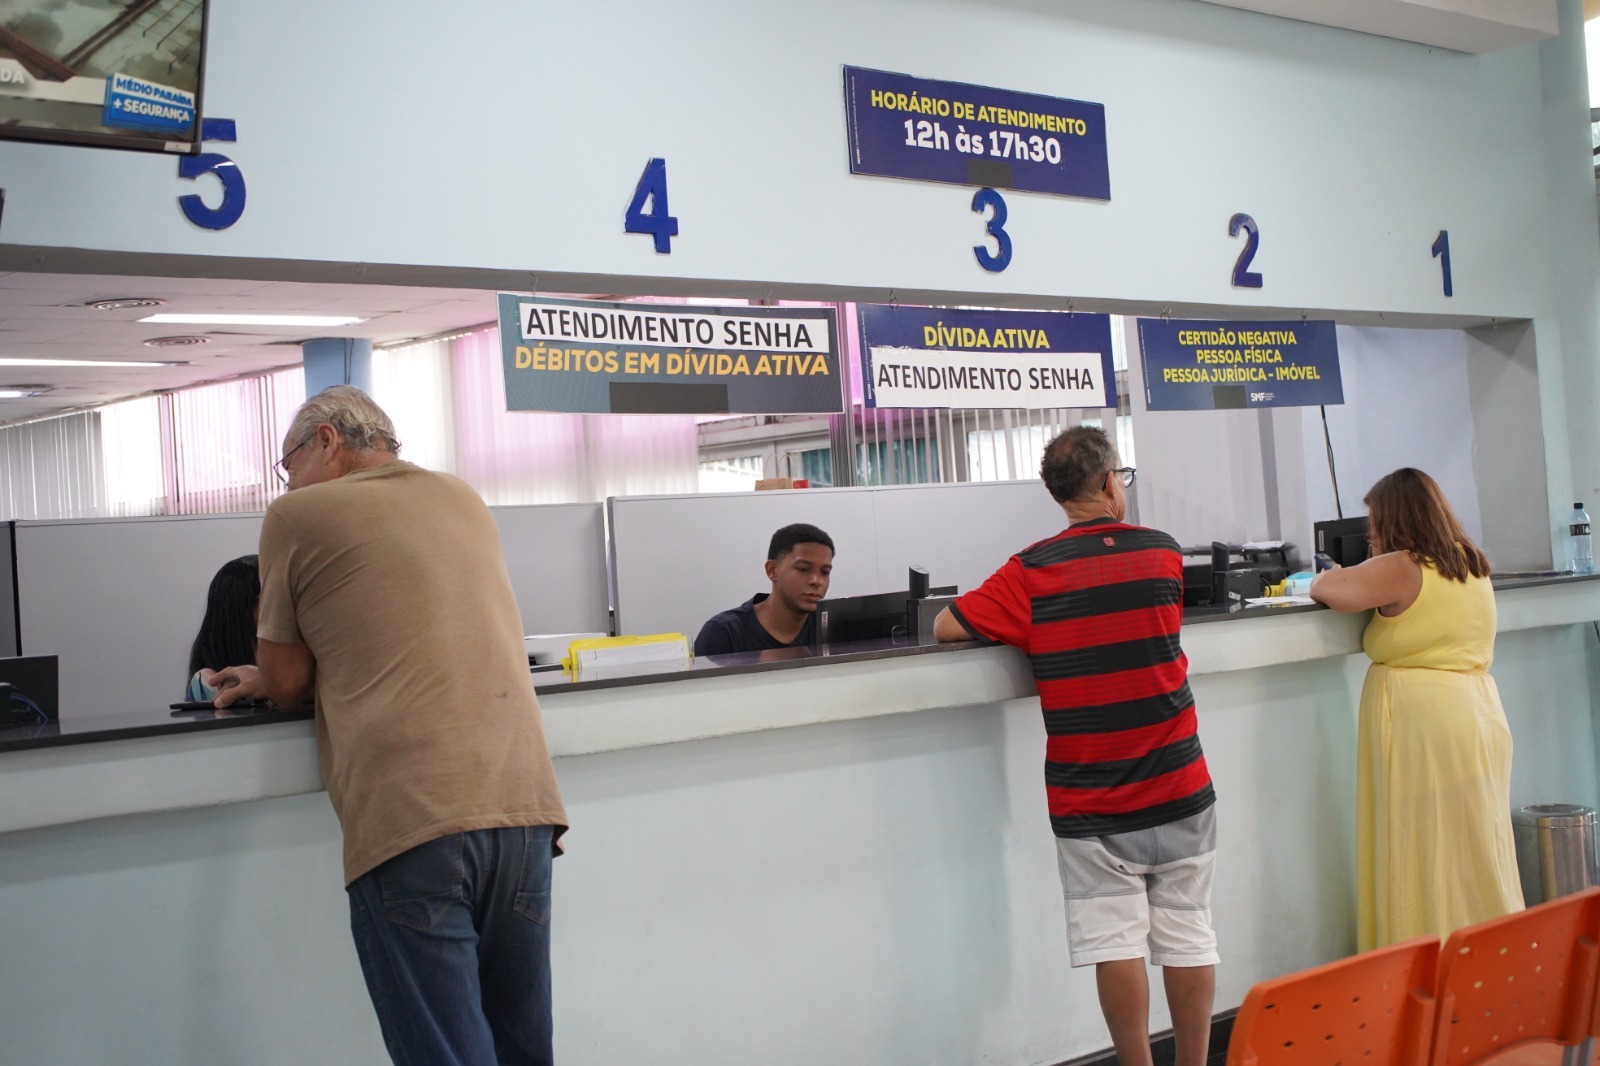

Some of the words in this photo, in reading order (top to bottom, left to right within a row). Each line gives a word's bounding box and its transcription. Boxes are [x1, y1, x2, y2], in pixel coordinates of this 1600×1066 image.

[116, 76, 152, 95] MÉDIO
[153, 87, 192, 107] PARAÍBA
[124, 99, 190, 123] SEGURANÇA
[871, 90, 950, 117] HORÁRIO
[953, 102, 975, 121] DE
[977, 106, 1087, 136] ATENDIMENTO
[904, 119, 949, 150] 12h
[955, 124, 984, 155] às
[989, 131, 1062, 165] 17h30
[179, 118, 246, 230] 5
[625, 157, 678, 254] 4
[972, 188, 1012, 272] 3
[1228, 213, 1263, 288] 2
[1431, 229, 1453, 298] 1
[526, 308, 714, 345] ATENDIMENTO
[723, 319, 814, 348] SENHA
[924, 322, 990, 348] DÍVIDA
[993, 329, 1051, 349] ATIVA
[1178, 328, 1236, 345] CERTIDÃO
[1238, 331, 1297, 345] NEGATIVA
[515, 342, 619, 373] DÉBITOS
[625, 352, 659, 375] EM
[666, 348, 751, 375] DÍVIDA
[754, 354, 829, 376] ATIVA
[1196, 350, 1243, 363] PESSOA
[1244, 346, 1283, 363] FÍSICA
[878, 364, 1022, 391] ATENDIMENTO
[1029, 367, 1094, 390] SENHA
[1163, 368, 1210, 383] PESSOA
[1210, 365, 1267, 382] JURÍDICA
[1275, 363, 1320, 381] IMÓVEL
[1250, 392, 1265, 402] SMF
